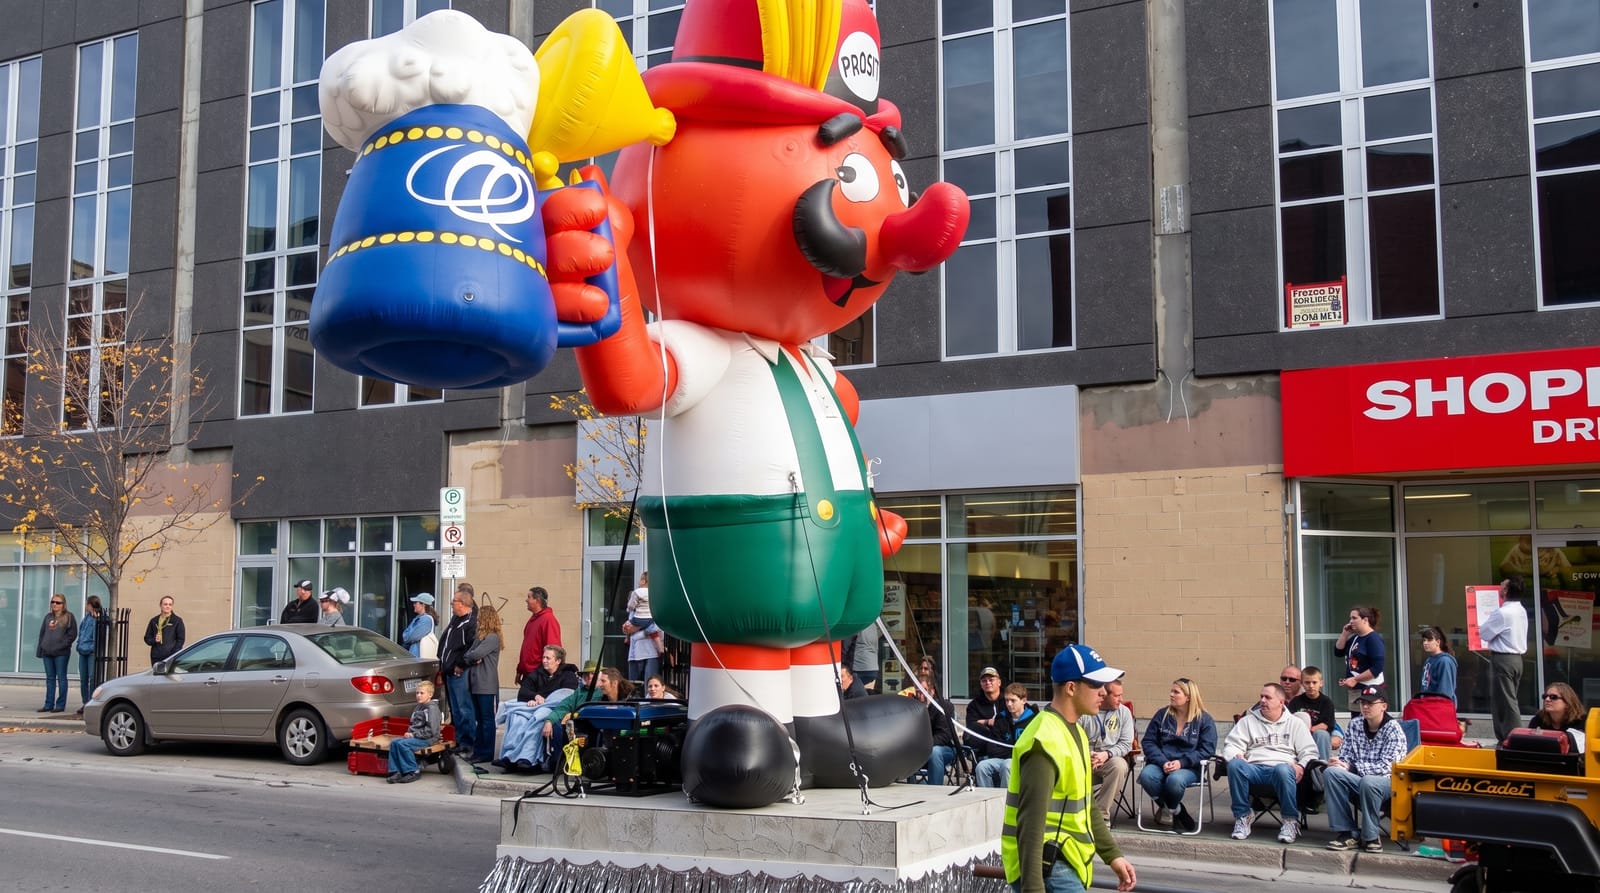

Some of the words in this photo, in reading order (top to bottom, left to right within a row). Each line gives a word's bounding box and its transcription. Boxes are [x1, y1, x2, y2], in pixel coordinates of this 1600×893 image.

[841, 51, 879, 82] PROSIT
[1362, 366, 1600, 420] SHOP
[1532, 417, 1600, 444] DR
[1437, 777, 1471, 792] Cub
[1473, 780, 1533, 797] Cadet
